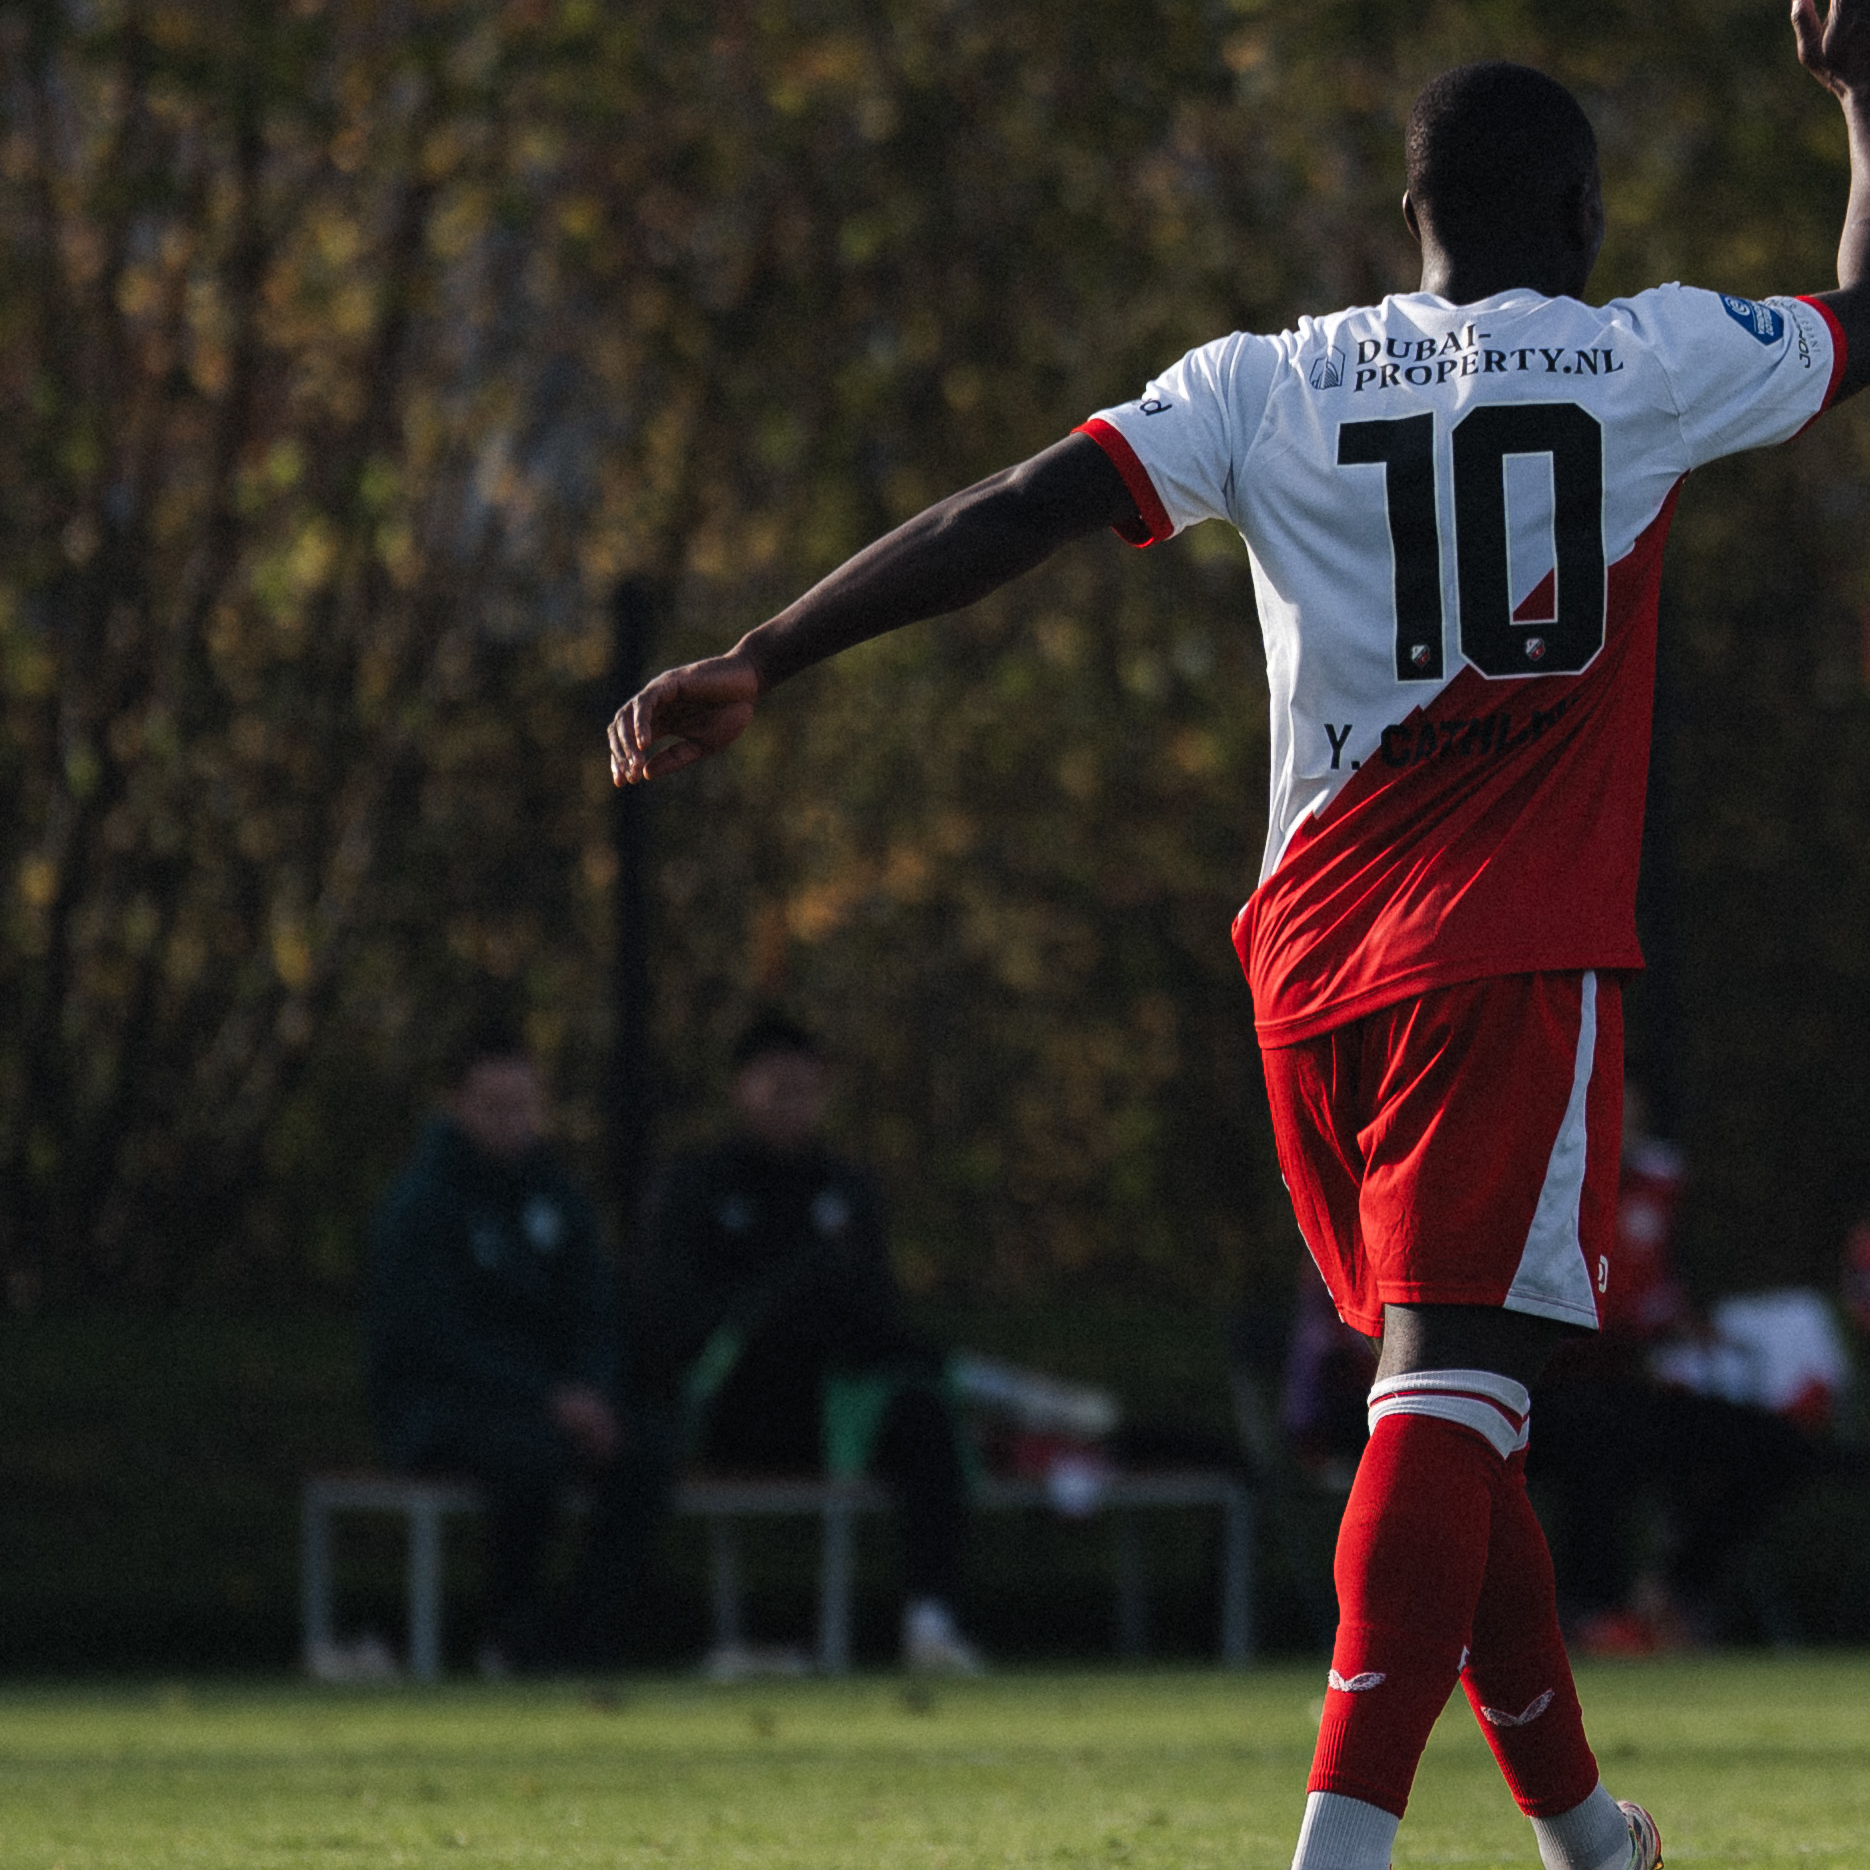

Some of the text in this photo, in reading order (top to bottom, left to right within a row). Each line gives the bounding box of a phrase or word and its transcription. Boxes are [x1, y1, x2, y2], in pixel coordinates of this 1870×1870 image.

[1357, 324, 1492, 366] DUBAI-
[1353, 348, 1624, 392] PROPERTY.NL
[1337, 402, 1605, 682] 10
[1324, 723, 1361, 770] Y.
